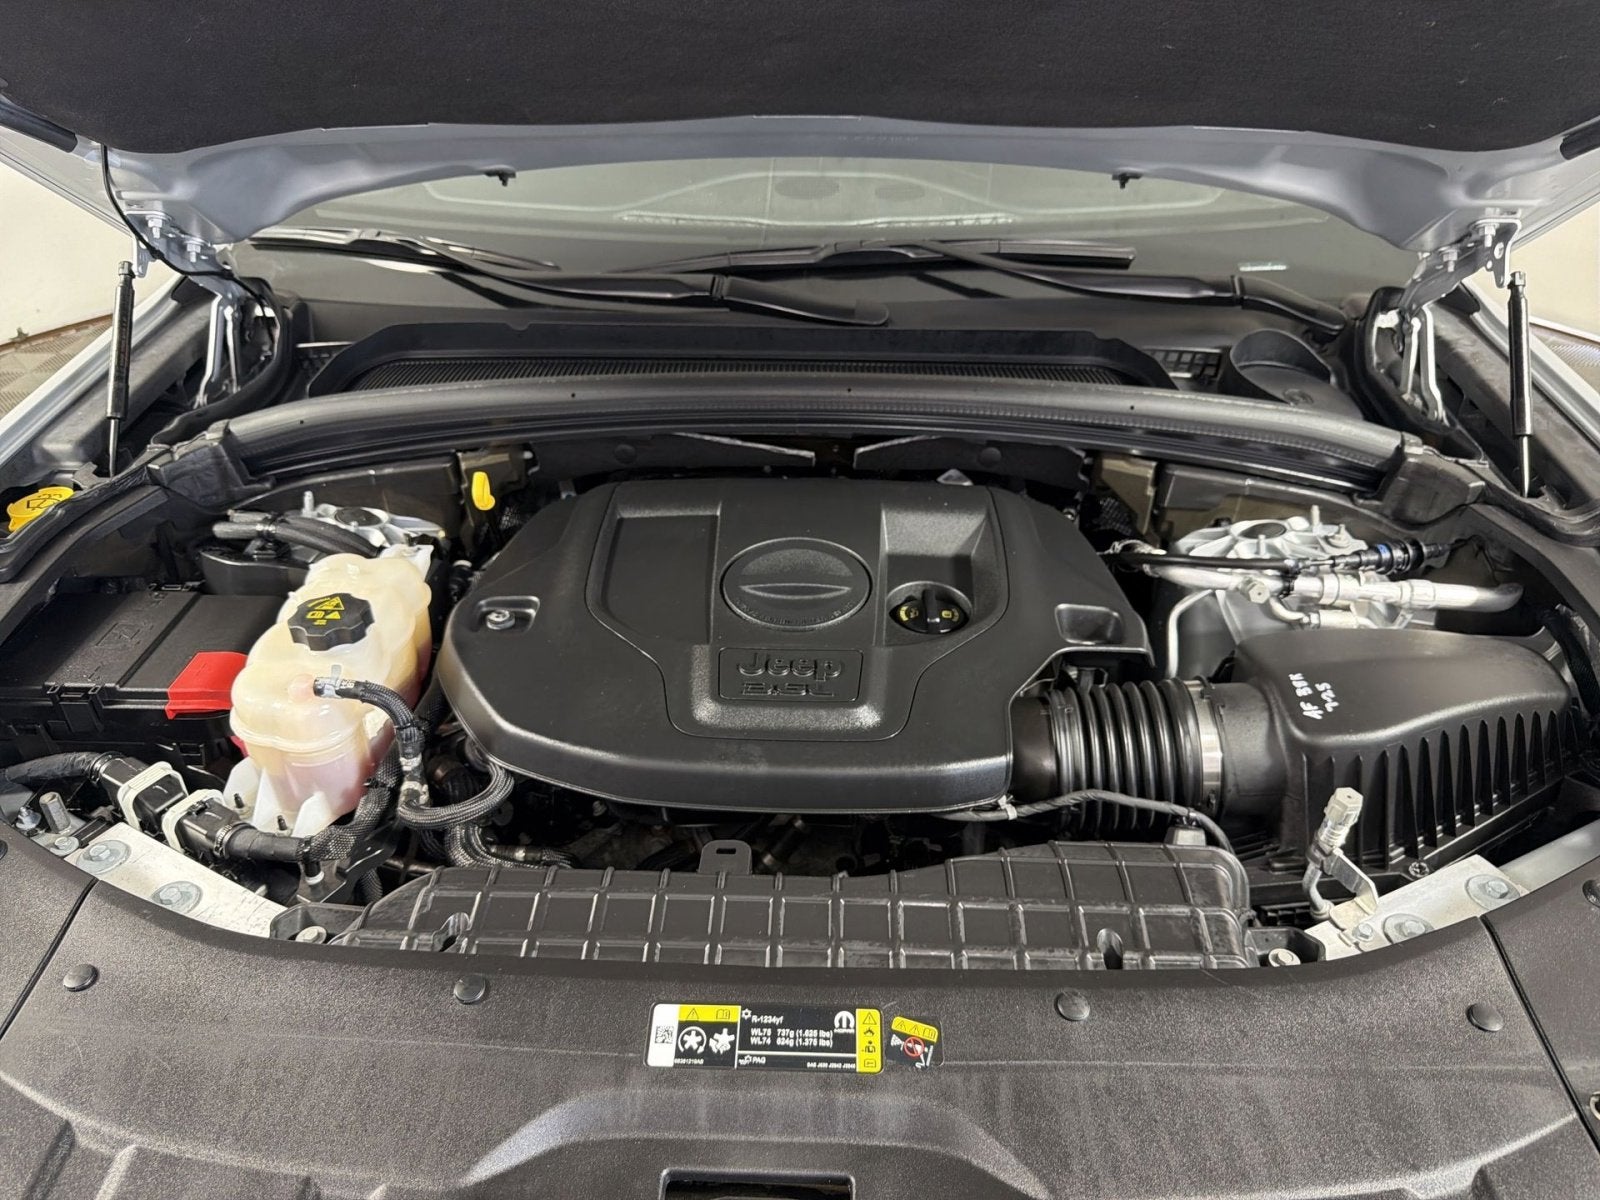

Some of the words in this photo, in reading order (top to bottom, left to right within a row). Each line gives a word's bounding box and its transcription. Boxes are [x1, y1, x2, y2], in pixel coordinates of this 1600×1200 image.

[737, 651, 842, 682] Jeep
[751, 1015, 784, 1025] R-1234yf
[777, 1028, 795, 1038] 737g
[750, 1036, 771, 1045] WL74
[752, 1056, 766, 1064] PAG
